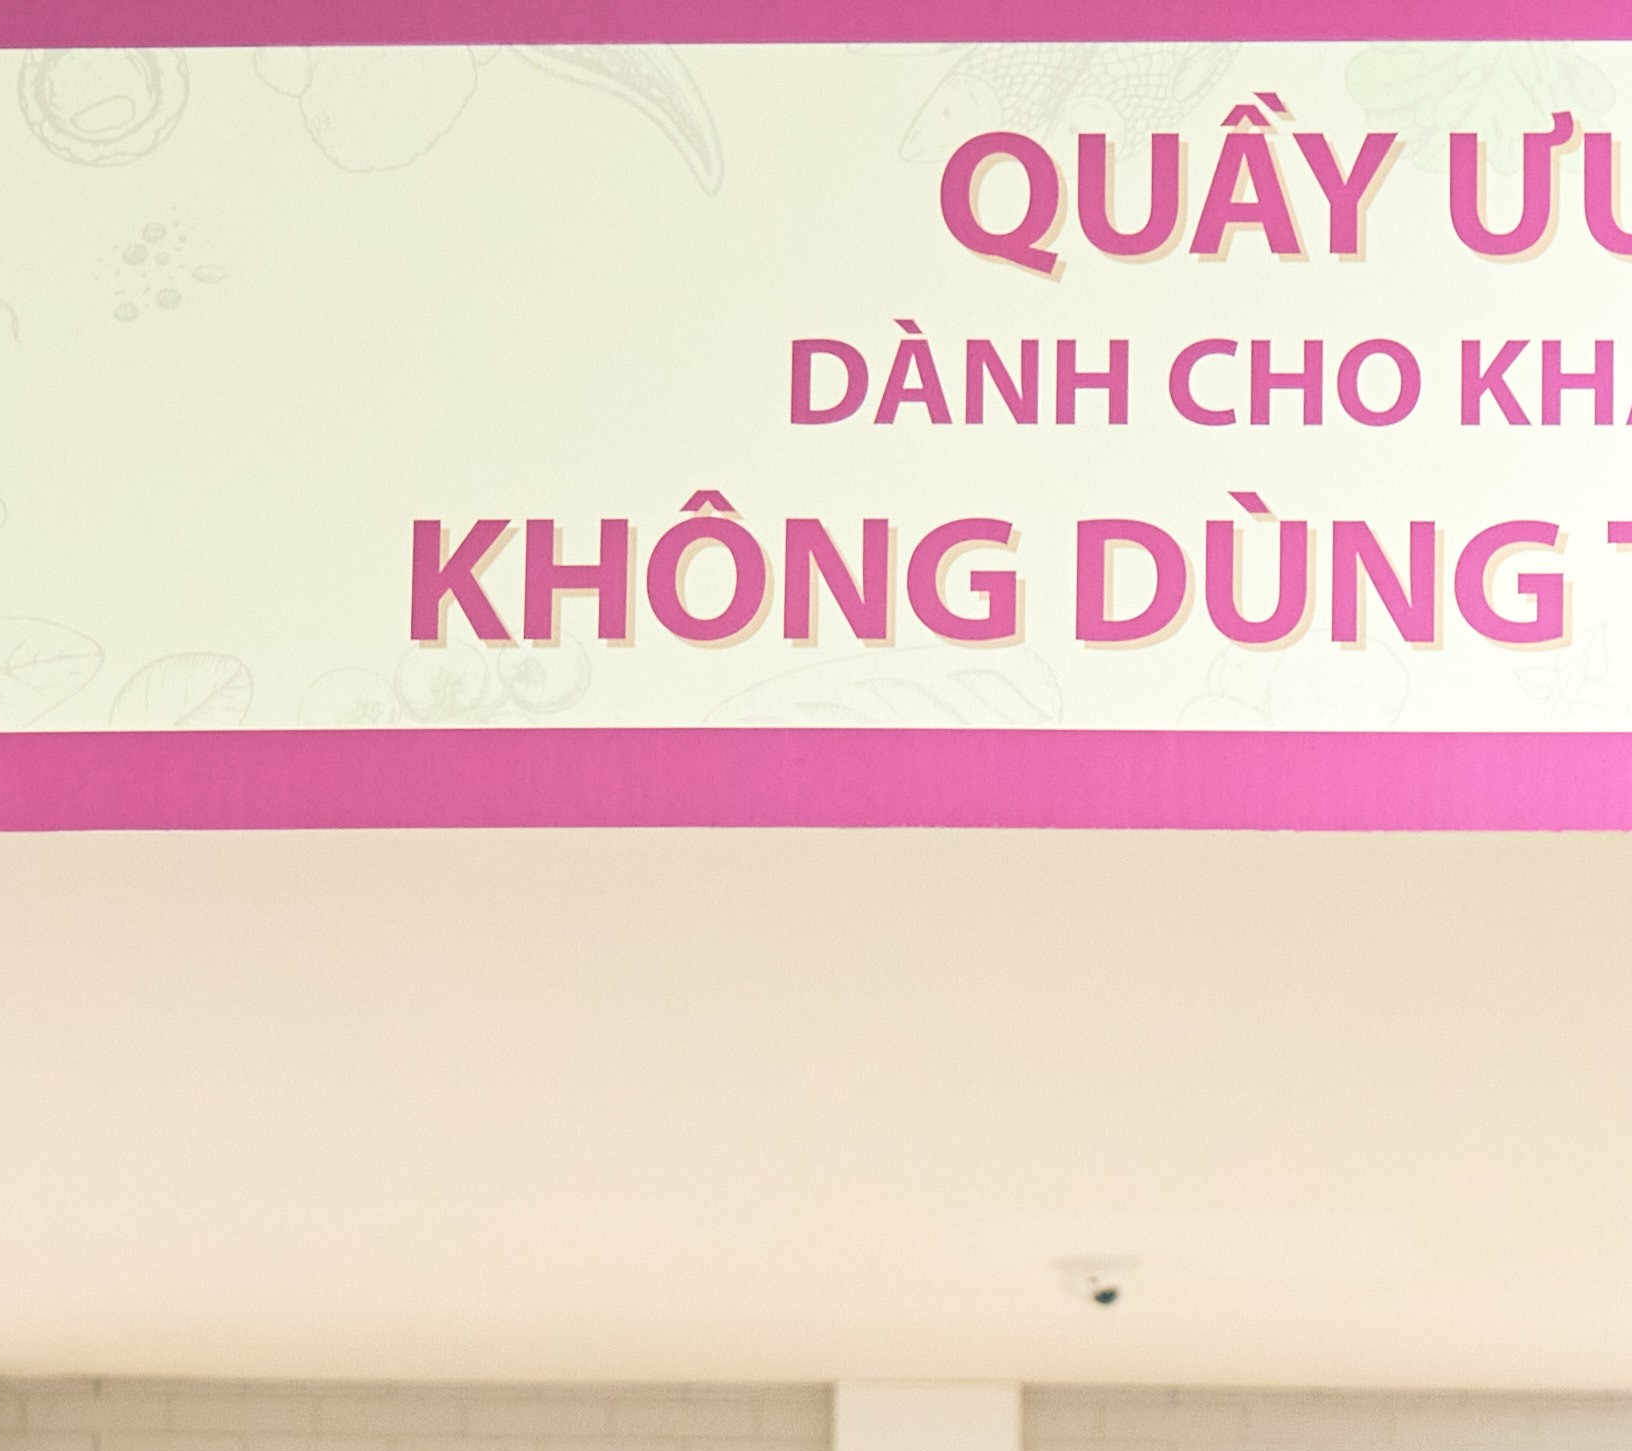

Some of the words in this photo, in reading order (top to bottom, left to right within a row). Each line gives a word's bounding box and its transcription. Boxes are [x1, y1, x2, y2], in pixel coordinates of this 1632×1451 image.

[939, 91, 1401, 279] QUẦY
[789, 319, 1131, 427] DÀNH
[1167, 337, 1423, 428] CHO
[410, 489, 1022, 646] KHÔNG
[1075, 491, 1570, 648] DÙNG
